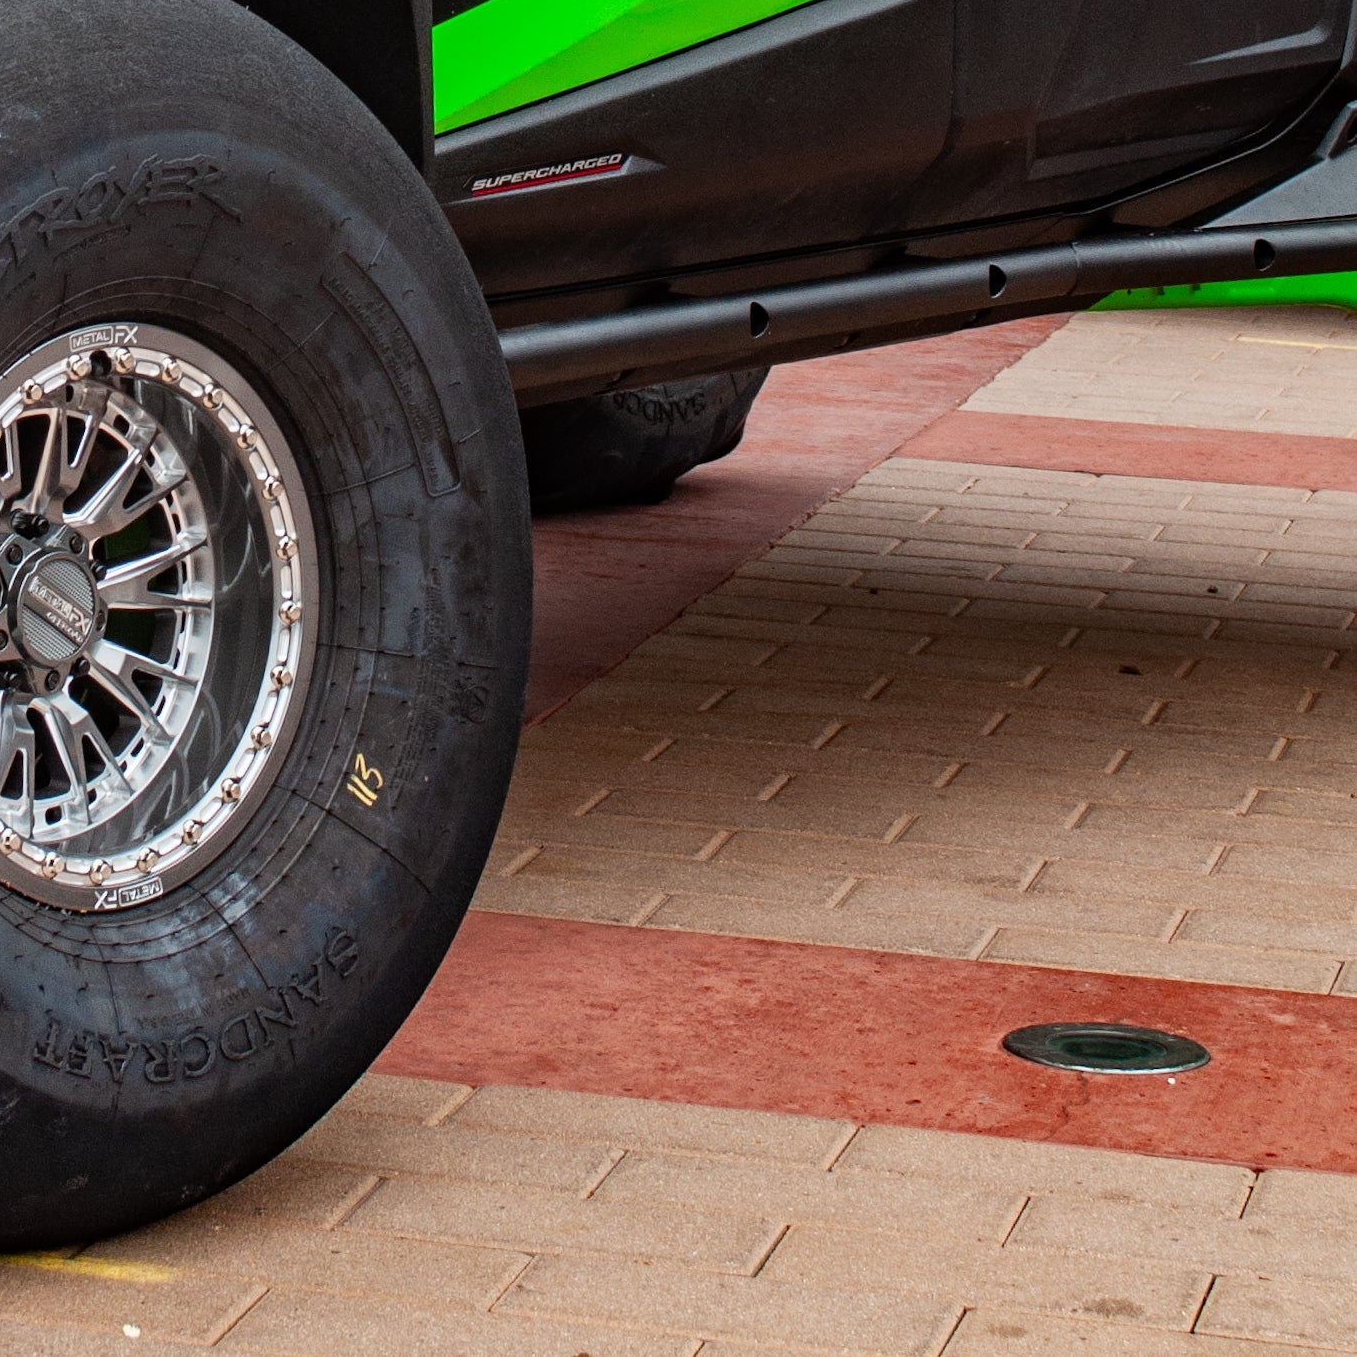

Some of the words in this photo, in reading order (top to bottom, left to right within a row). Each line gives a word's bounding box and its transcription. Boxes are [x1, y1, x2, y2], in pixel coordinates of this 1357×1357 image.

[471, 153, 624, 192] SUPERCHARGED
[72, 330, 111, 349] METAL
[114, 325, 139, 344] FX
[94, 889, 118, 910] FX
[121, 880, 160, 903] METAL
[32, 926, 361, 1086] SANDCRAFT
